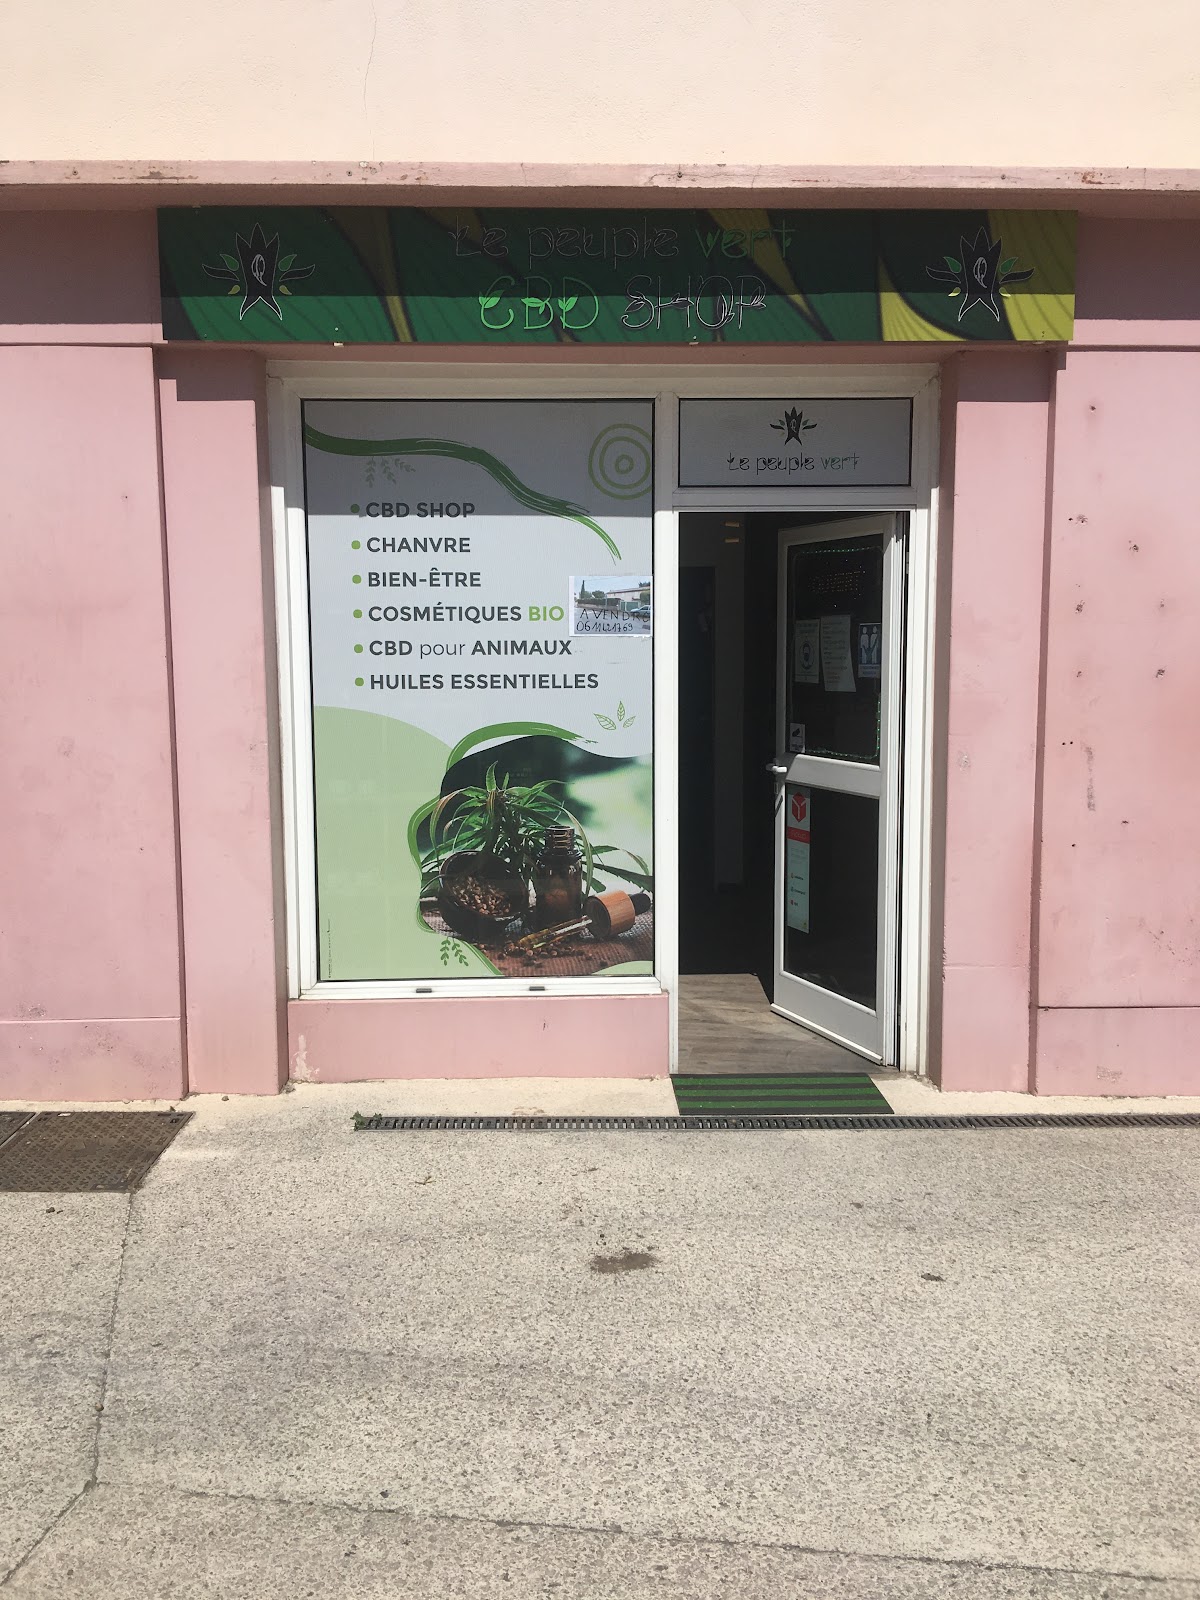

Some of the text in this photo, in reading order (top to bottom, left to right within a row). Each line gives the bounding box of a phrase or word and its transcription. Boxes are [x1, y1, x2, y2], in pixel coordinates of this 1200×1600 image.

[448, 215, 798, 270] Le peuple vert
[478, 274, 768, 331] CBD SHOP
[727, 452, 860, 475] Le peuple vert
[365, 502, 475, 518] CBD SHOP
[366, 537, 471, 553] CHANVRE
[368, 567, 481, 588] BIEN-ÊTRE
[368, 602, 565, 624] COSMÉTIQUES BIO
[369, 640, 572, 659] CBD pour ANIMAUX
[370, 673, 599, 690] HUILES ESSENTIELLES
